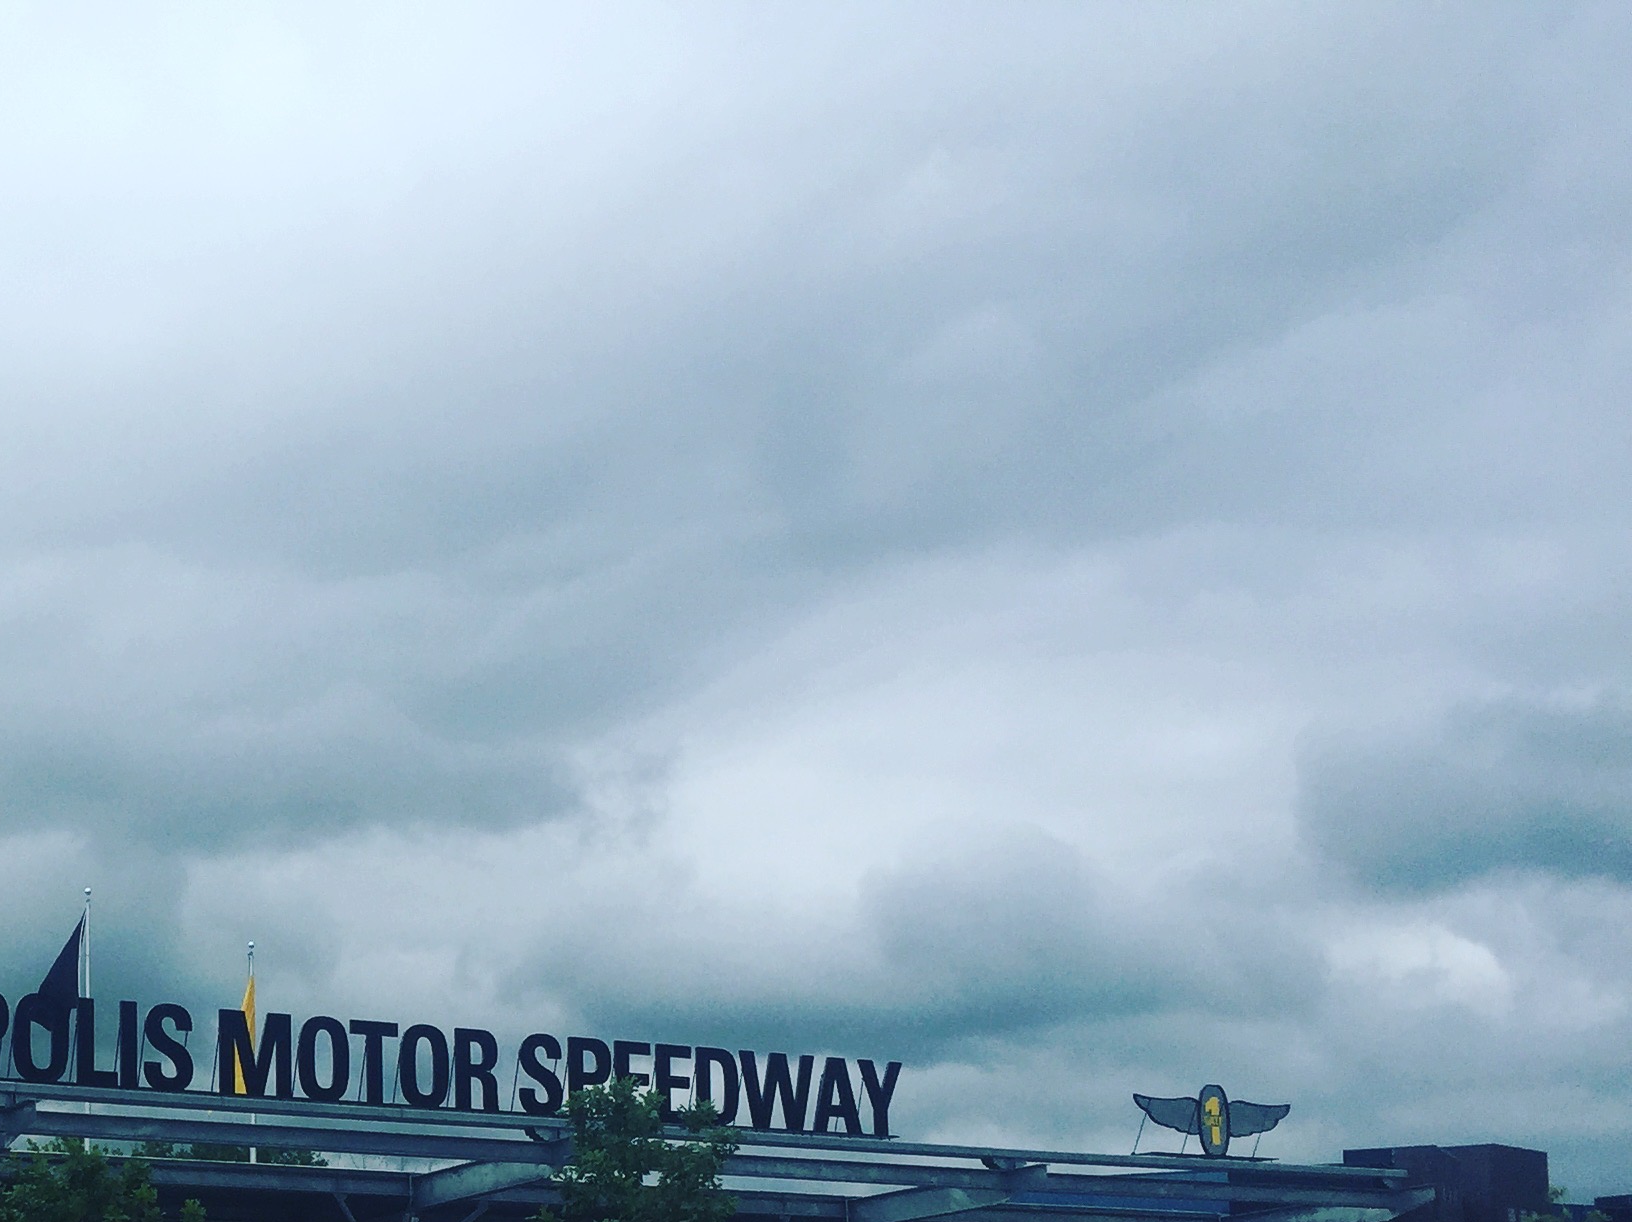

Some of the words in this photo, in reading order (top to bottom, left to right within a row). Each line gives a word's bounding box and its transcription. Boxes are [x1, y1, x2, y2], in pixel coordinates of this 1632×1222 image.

[217, 1009, 499, 1113] MOTOR
[518, 1033, 902, 1137] SPEEDWAY
[1205, 1097, 1220, 1145] 1
